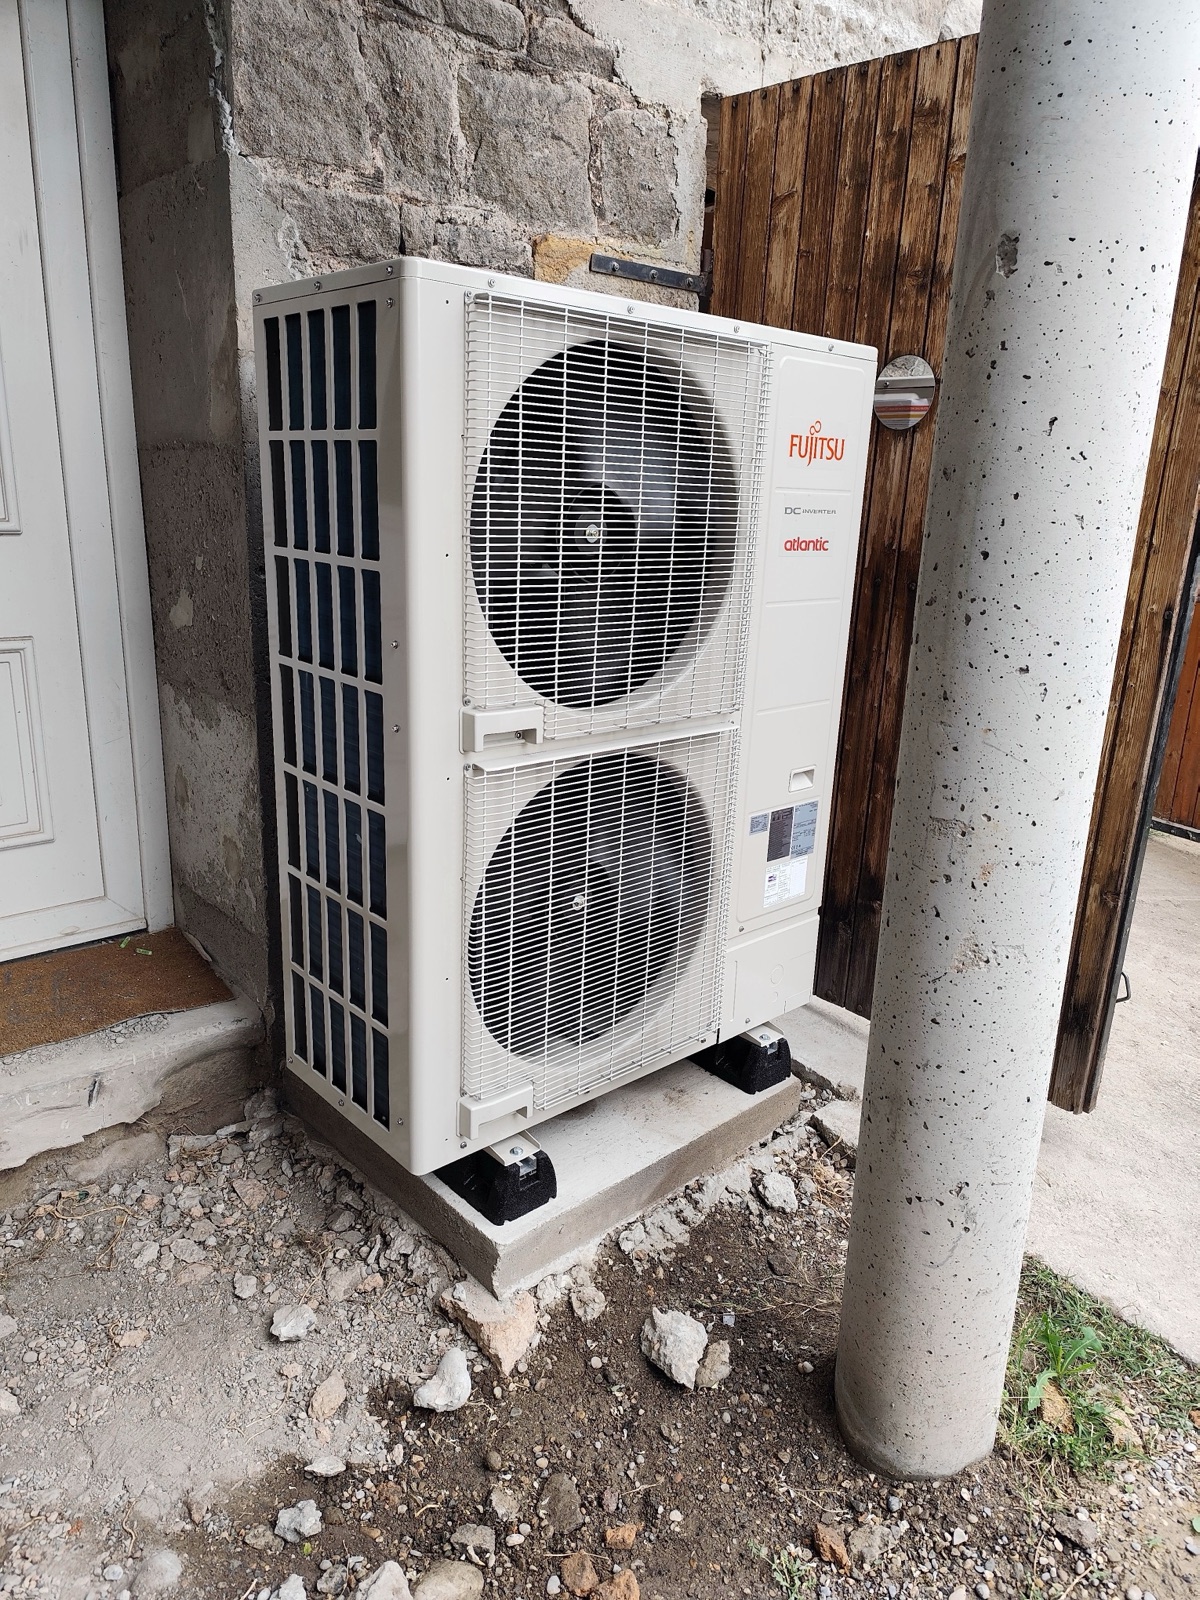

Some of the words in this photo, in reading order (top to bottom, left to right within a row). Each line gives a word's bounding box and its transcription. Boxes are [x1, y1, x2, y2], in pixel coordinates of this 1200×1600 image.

[789, 430, 845, 466] FUJITSU
[784, 507, 801, 515] DC
[784, 537, 829, 551] atlantic
